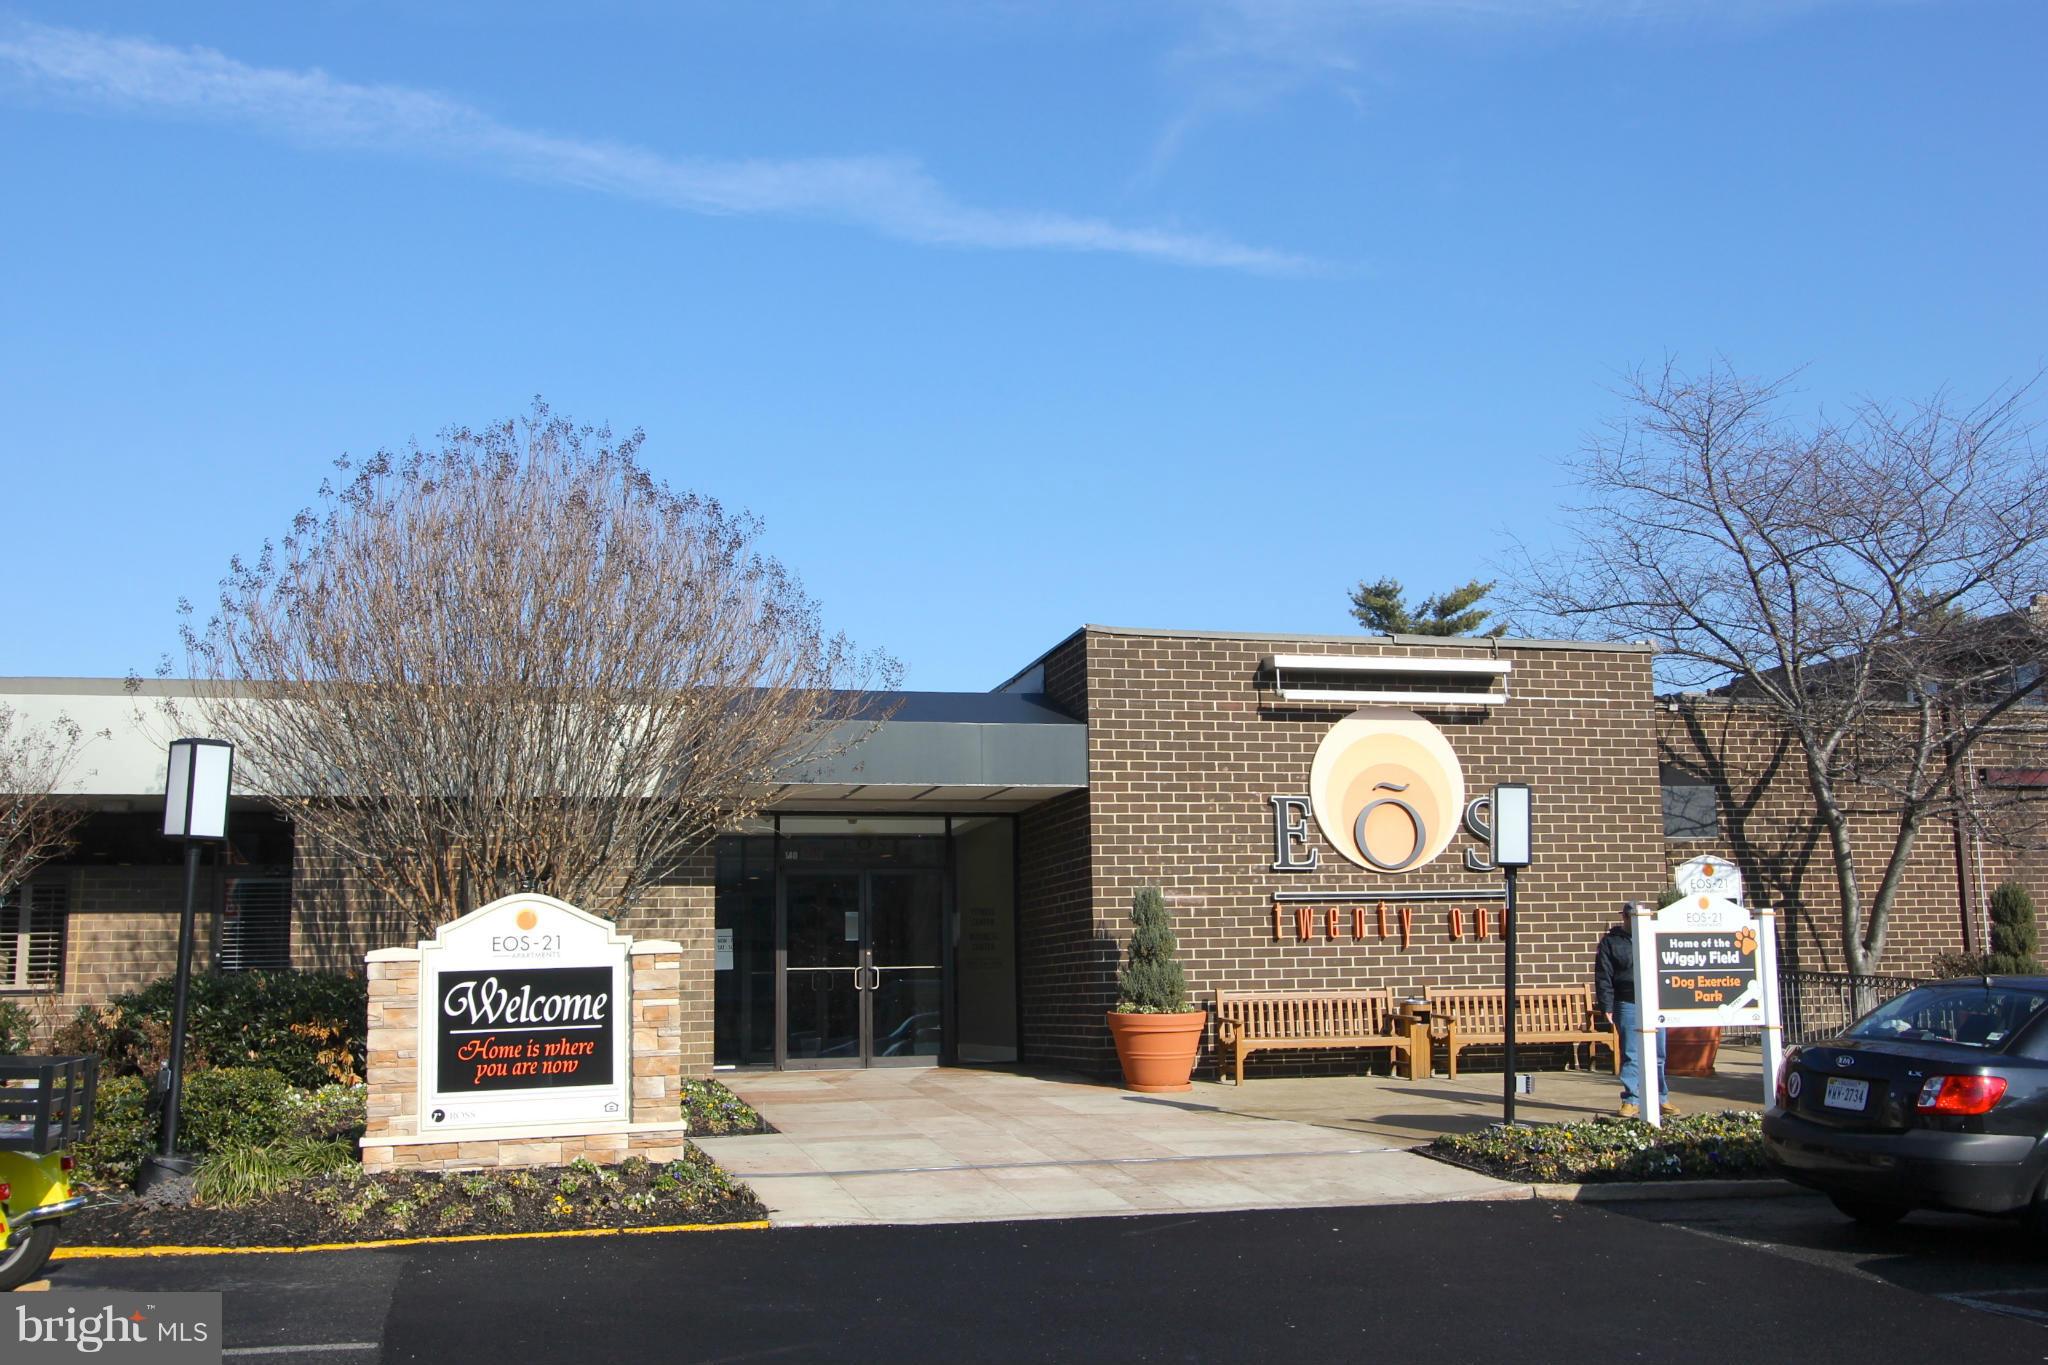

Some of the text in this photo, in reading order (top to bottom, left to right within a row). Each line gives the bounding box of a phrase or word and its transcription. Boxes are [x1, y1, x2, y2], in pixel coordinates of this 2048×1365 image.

[1273, 901, 1508, 948] twenty on
[492, 935, 561, 952] EOS-21
[1669, 938, 1730, 948] Home of the
[1661, 951, 1740, 967] Wiggly Field
[1671, 976, 1741, 988] Dog Exercise
[444, 976, 608, 1025] Welcome
[1694, 990, 1723, 1002] Park
[458, 1036, 594, 1061] Home is where
[475, 1058, 579, 1085] you are now
